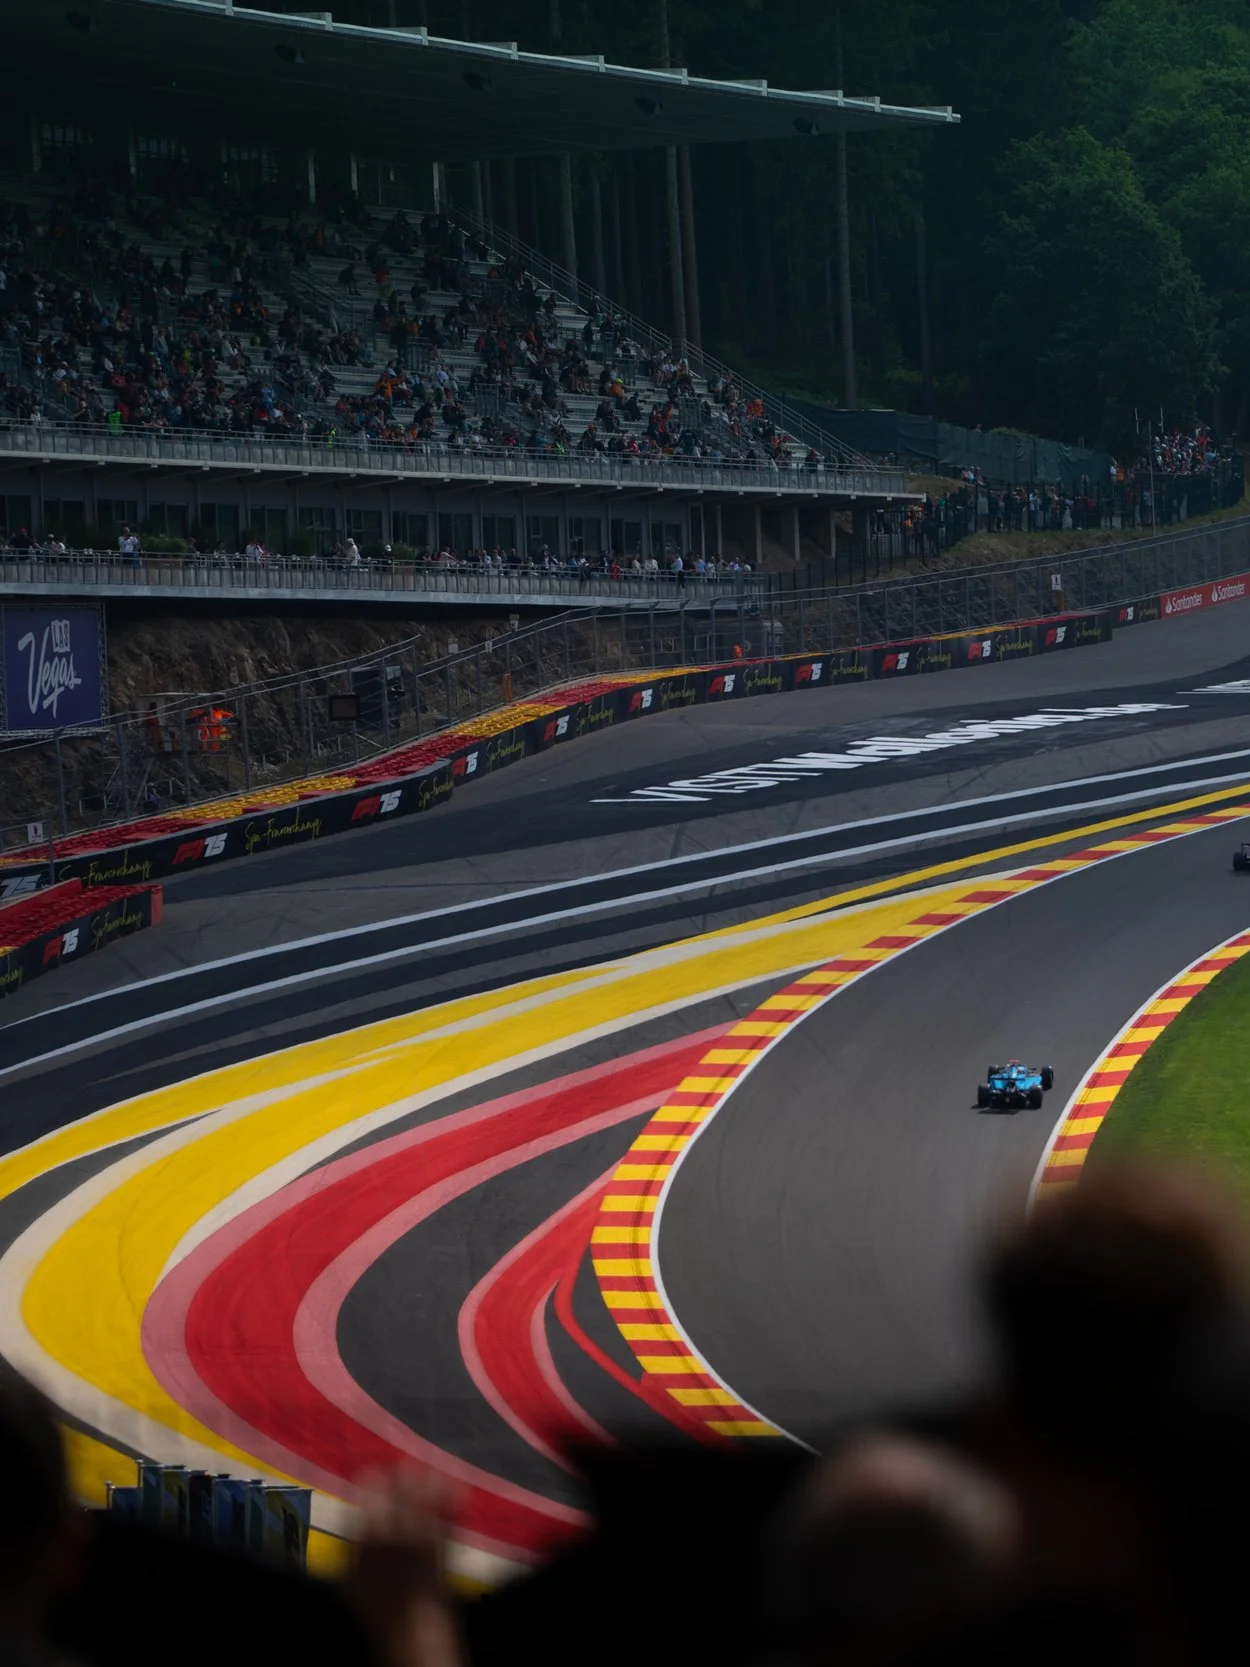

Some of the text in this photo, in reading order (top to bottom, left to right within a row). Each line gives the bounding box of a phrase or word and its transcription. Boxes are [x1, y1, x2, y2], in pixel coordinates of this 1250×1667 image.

[1217, 579, 1245, 600] Santander
[1171, 592, 1202, 612] Santander
[18, 625, 82, 718] Vegas
